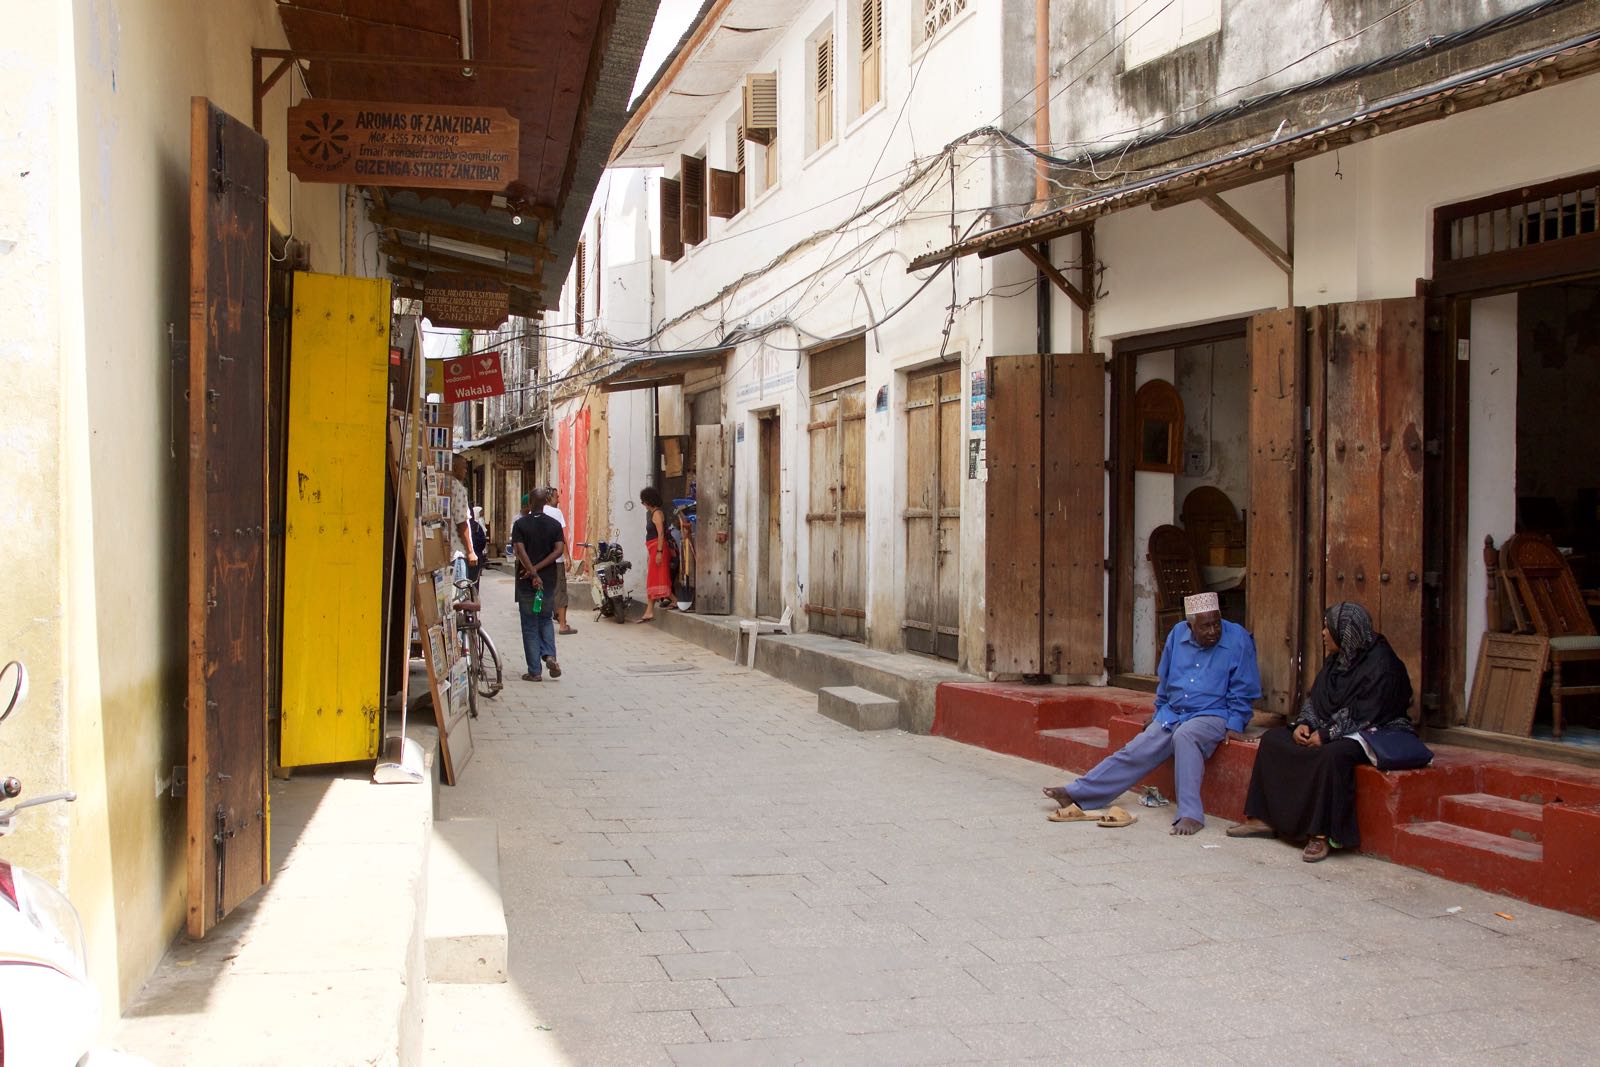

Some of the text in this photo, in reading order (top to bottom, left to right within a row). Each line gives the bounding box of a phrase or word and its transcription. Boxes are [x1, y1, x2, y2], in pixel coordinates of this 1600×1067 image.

[355, 111, 491, 134] AROMAS OF ZANZIBAR
[391, 132, 409, 144] +255
[411, 134, 427, 144] 784
[429, 135, 460, 146] 200242
[430, 304, 502, 316] GIZENGA STREET
[438, 312, 488, 322] ZANZIBAR
[455, 384, 493, 398] Wakala
